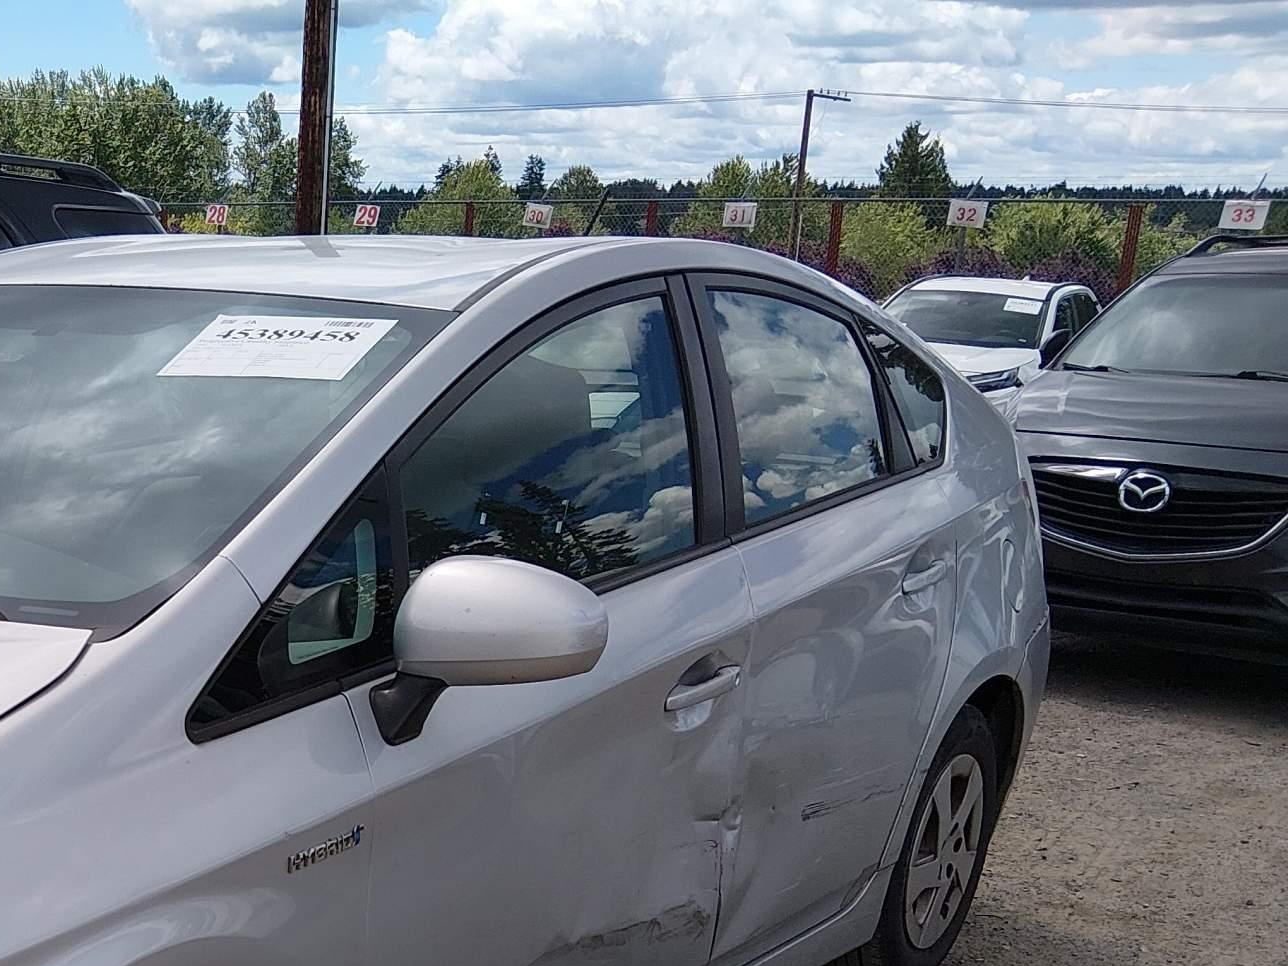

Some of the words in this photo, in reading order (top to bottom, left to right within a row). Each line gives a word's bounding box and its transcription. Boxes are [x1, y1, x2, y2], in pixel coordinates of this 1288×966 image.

[208, 205, 226, 224] 28
[355, 205, 379, 225] 29
[528, 210, 544, 224] 30
[729, 209, 746, 223] 31
[956, 207, 977, 222] 32
[1231, 208, 1255, 223] 33
[215, 328, 361, 343] 45389458
[287, 825, 362, 874] HYBRID
